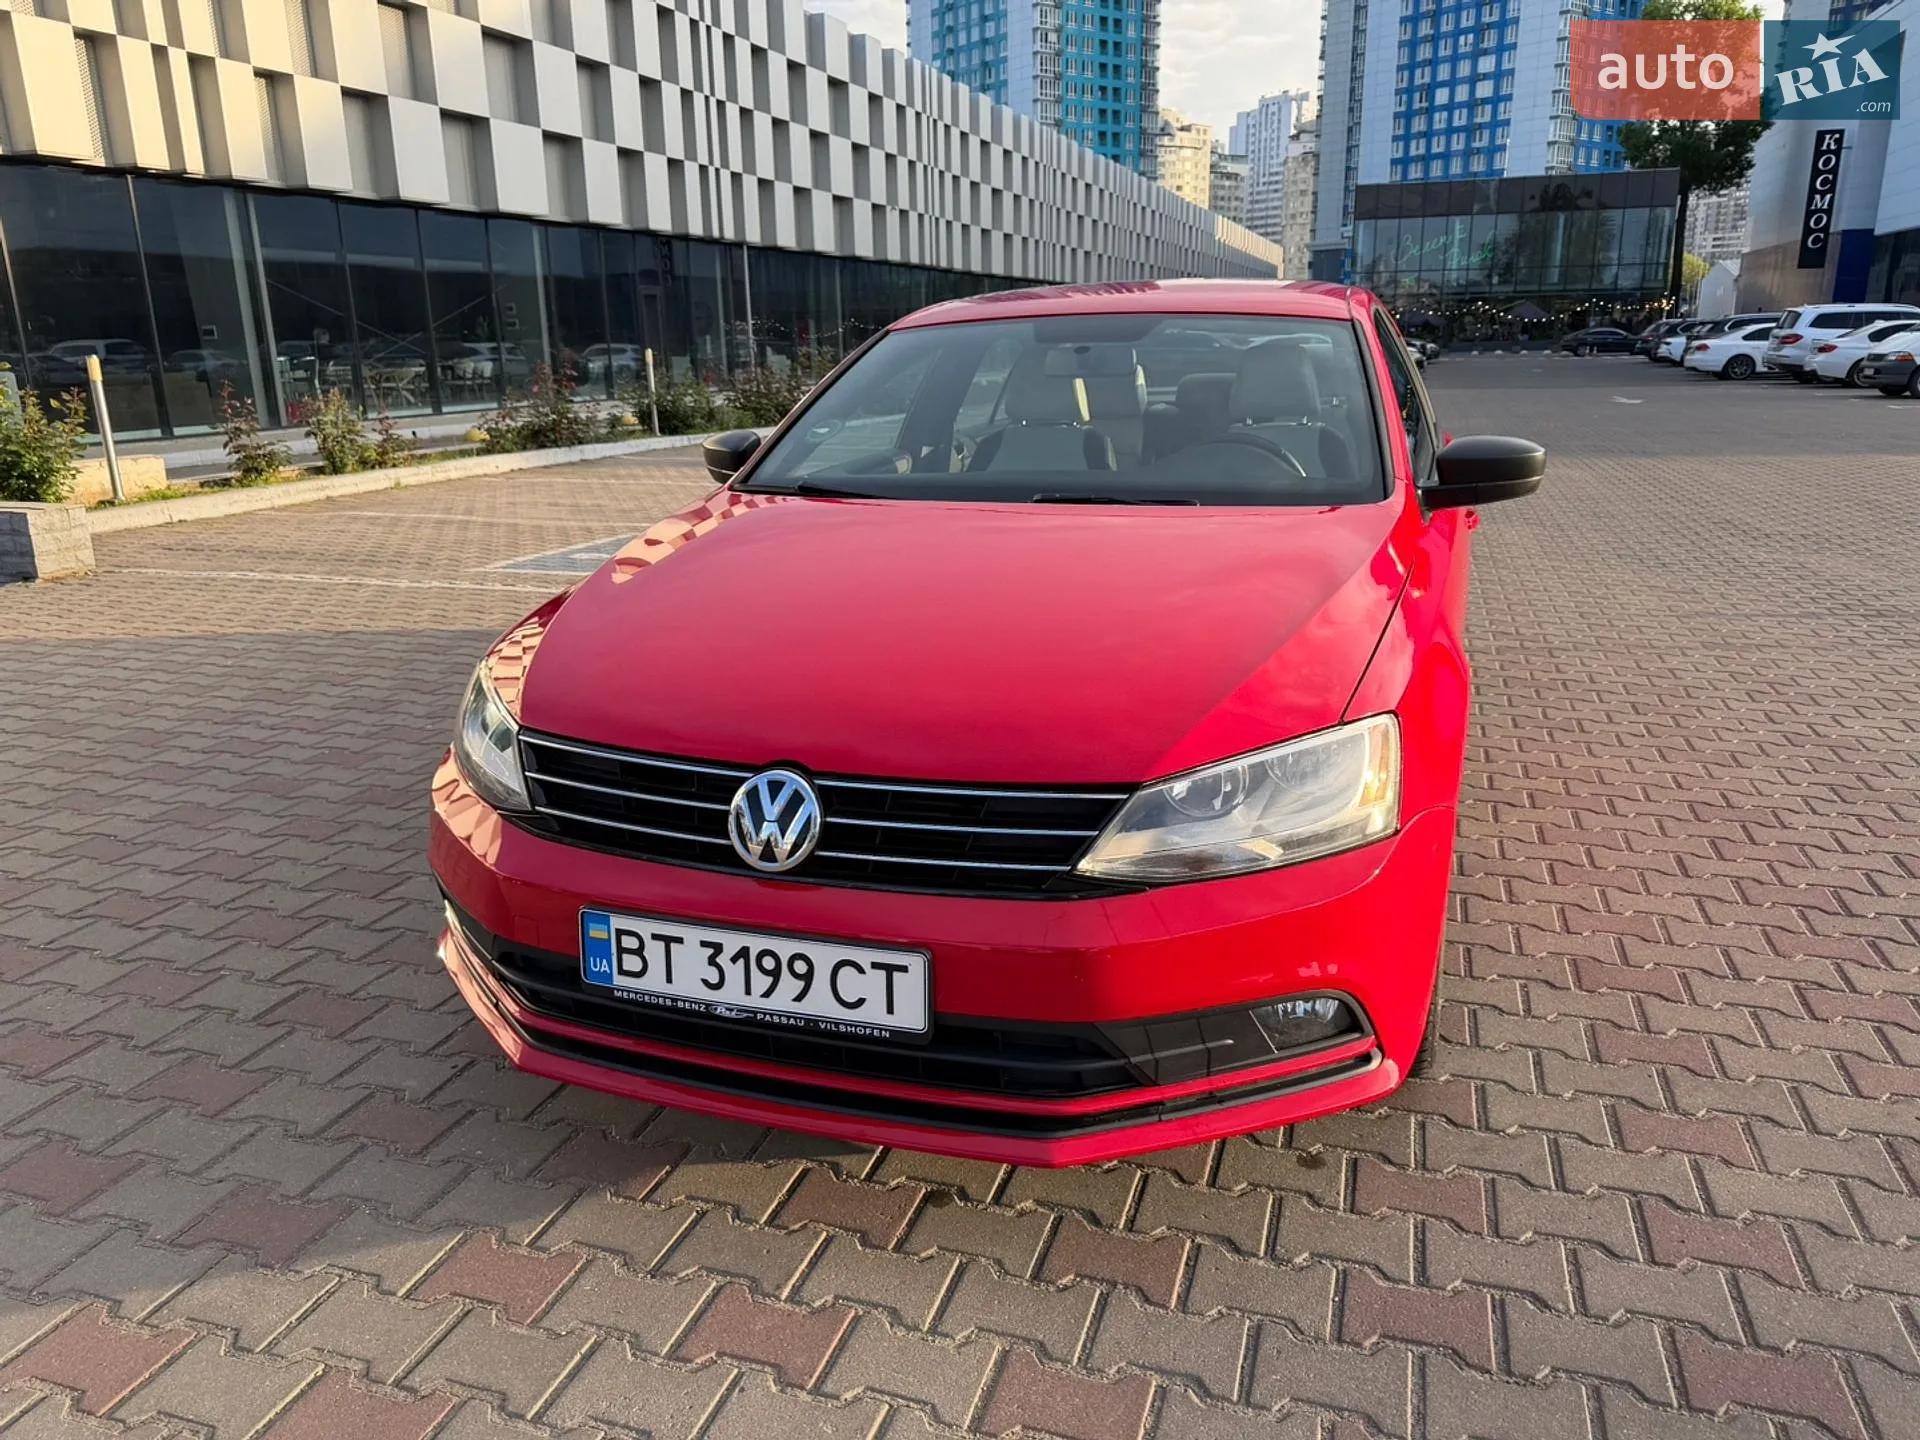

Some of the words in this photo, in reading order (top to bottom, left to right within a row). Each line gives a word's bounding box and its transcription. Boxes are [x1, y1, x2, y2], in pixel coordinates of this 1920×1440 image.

[1807, 133, 1840, 249] КОСМОС
[734, 774, 816, 867] VW
[590, 957, 611, 974] UA
[615, 928, 685, 984] BT
[700, 940, 815, 1003] 3199
[830, 959, 909, 1016] CT
[614, 989, 707, 1012] MERCEDES-BENZ
[756, 1013, 805, 1027] PASSAU
[818, 1021, 890, 1038] VILSHOFEN
